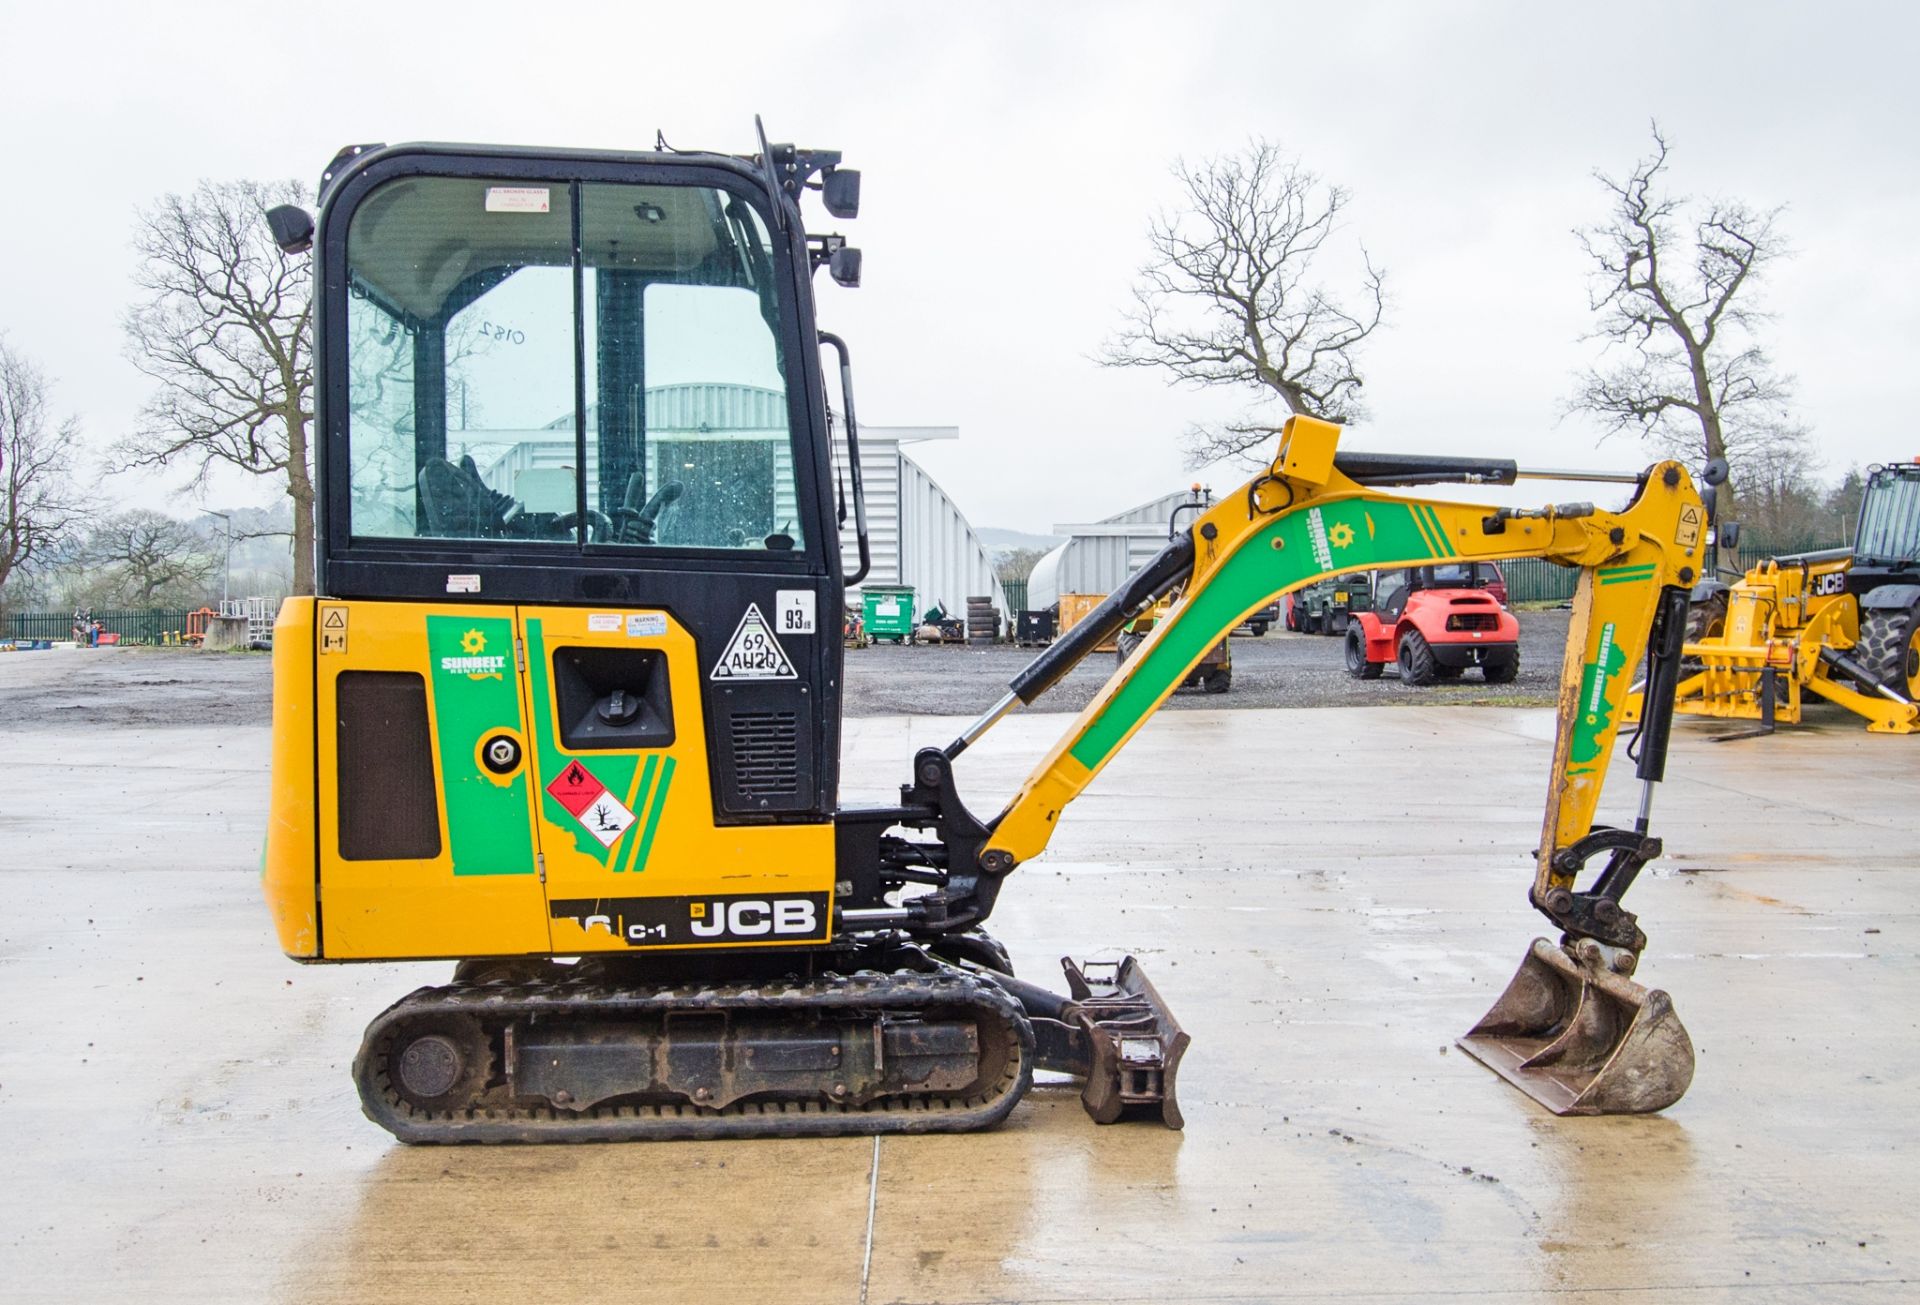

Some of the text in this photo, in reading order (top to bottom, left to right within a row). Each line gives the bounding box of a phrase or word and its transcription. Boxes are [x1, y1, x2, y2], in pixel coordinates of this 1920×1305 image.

[1305, 518, 1320, 564] RENTALS
[1308, 507, 1334, 573] SUNBELT
[1817, 572, 1844, 596] JCB
[786, 609, 803, 629] 93
[743, 633, 764, 651] 69
[441, 656, 506, 669] SUNBELT
[1589, 623, 1614, 713] SUNBELT RENTALS
[690, 900, 817, 936] JCB
[628, 924, 667, 938] C-1
